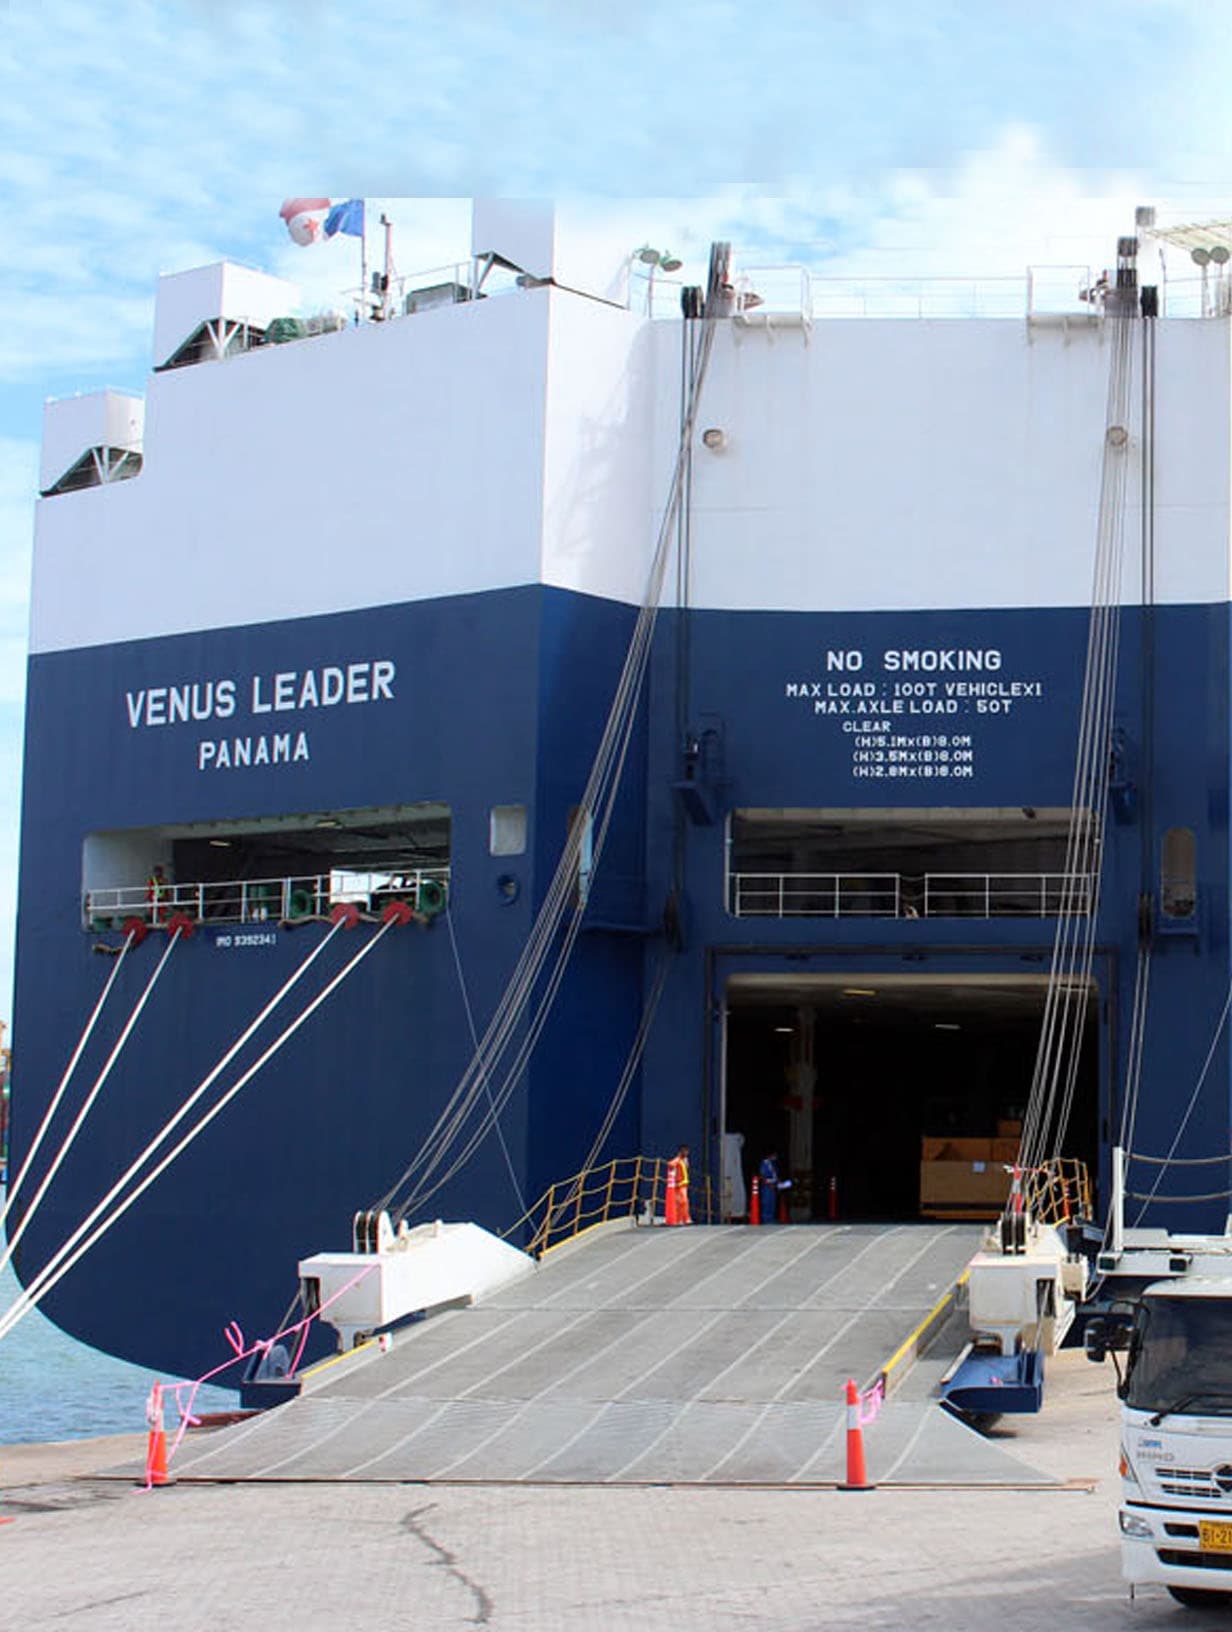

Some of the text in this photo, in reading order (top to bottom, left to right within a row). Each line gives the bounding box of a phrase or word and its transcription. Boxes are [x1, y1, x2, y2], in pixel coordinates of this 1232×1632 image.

[827, 649, 1002, 671] NO SMOKING
[126, 661, 397, 728] VENUS LEADER
[827, 682, 876, 697] LOAD
[894, 682, 937, 697] 100T
[909, 699, 958, 714] LOAD
[976, 699, 1013, 714] 50T
[842, 720, 892, 733] CLEAR
[199, 732, 310, 770] PANAMA
